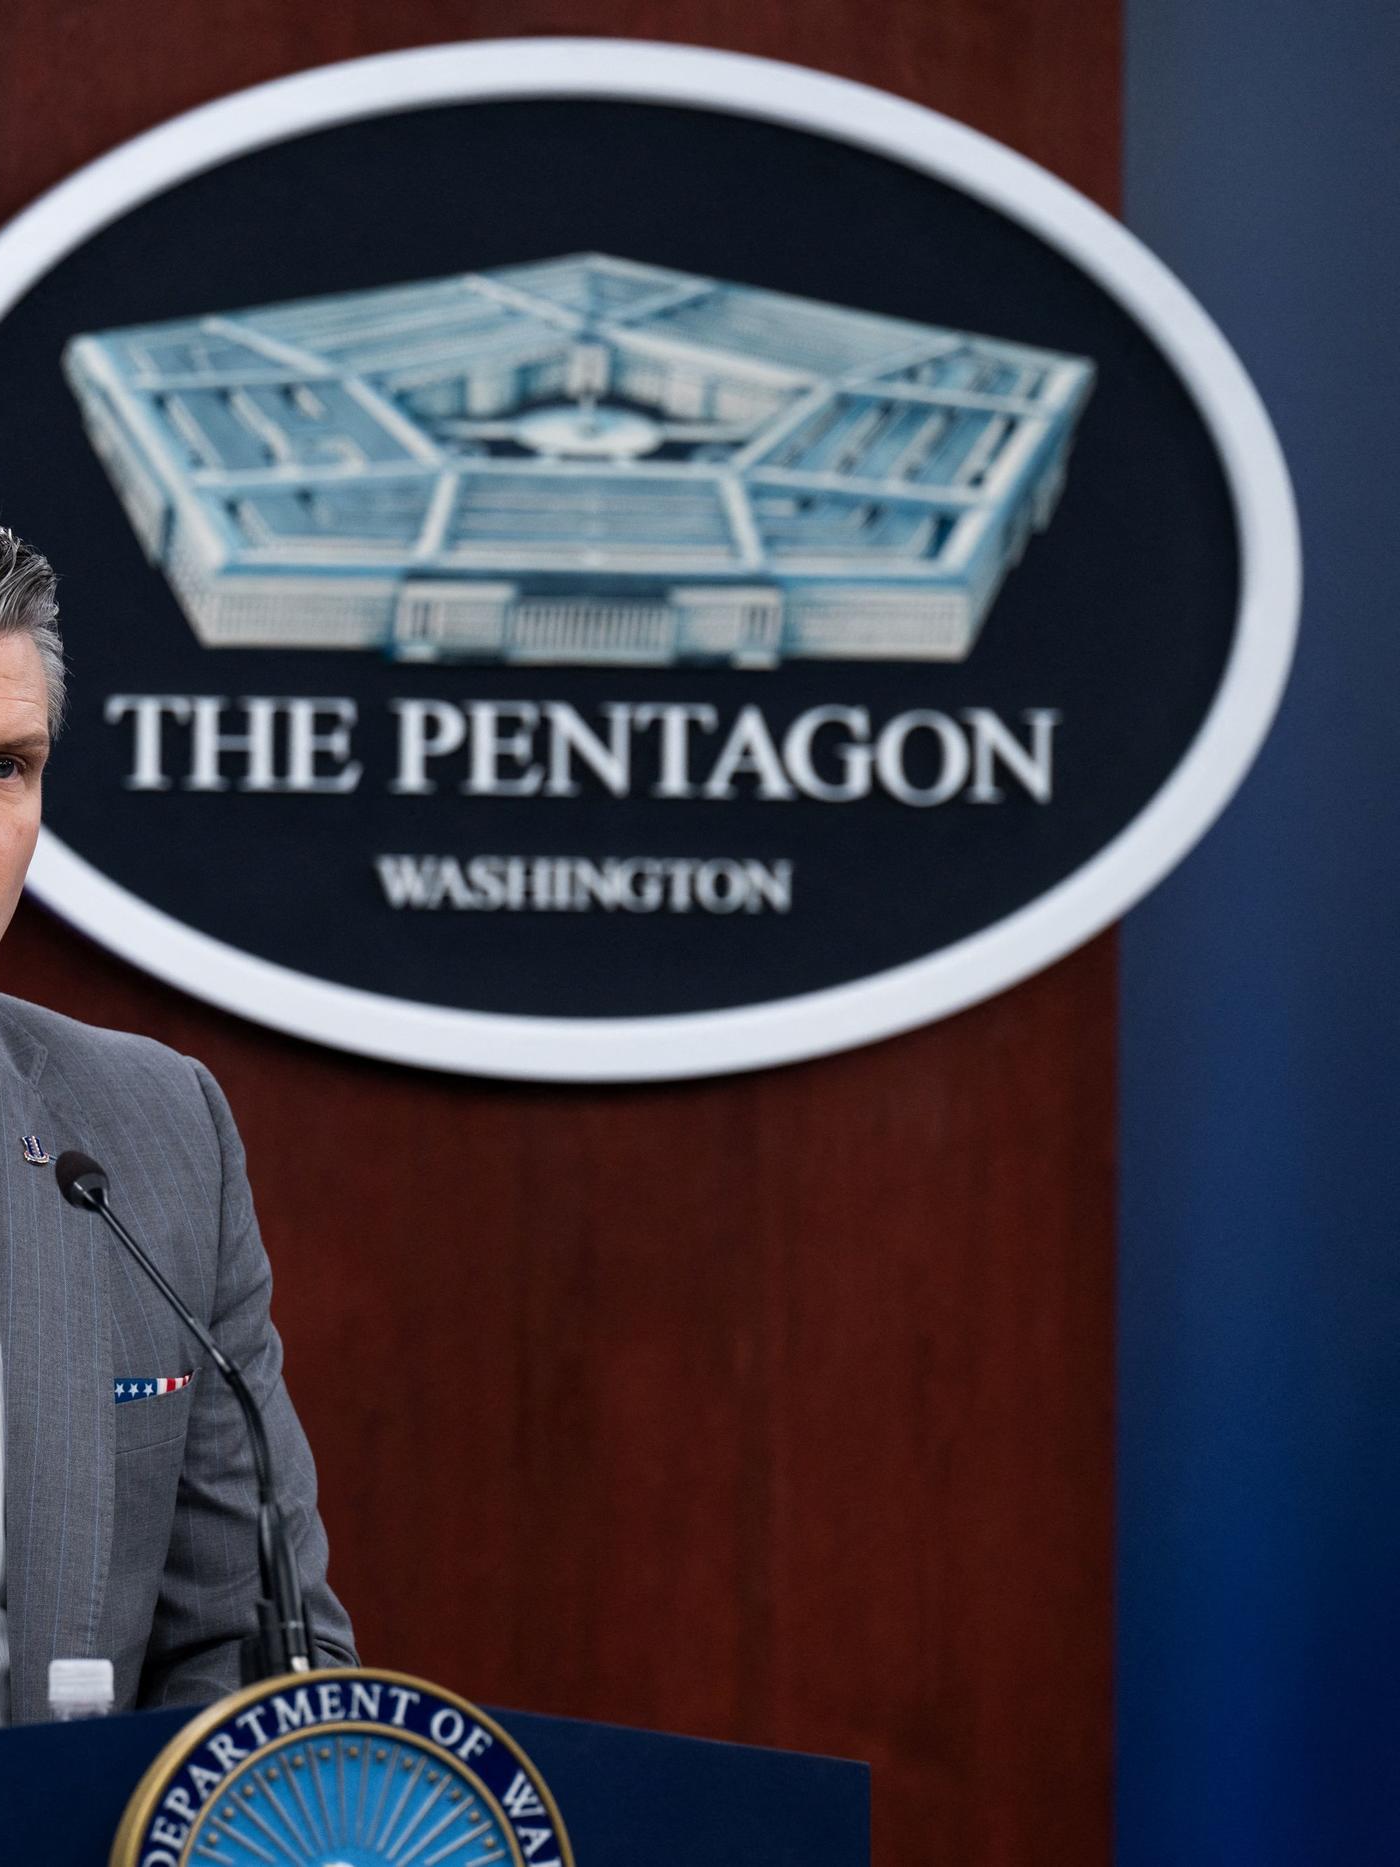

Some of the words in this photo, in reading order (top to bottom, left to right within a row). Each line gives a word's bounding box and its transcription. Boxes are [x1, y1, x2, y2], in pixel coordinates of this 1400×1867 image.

[105, 693, 363, 793] THE
[392, 697, 1060, 807] PENTAGON
[376, 854, 793, 913] WASHINGTON
[141, 1682, 421, 1867] DEPARTMENT
[429, 1707, 494, 1761] OF
